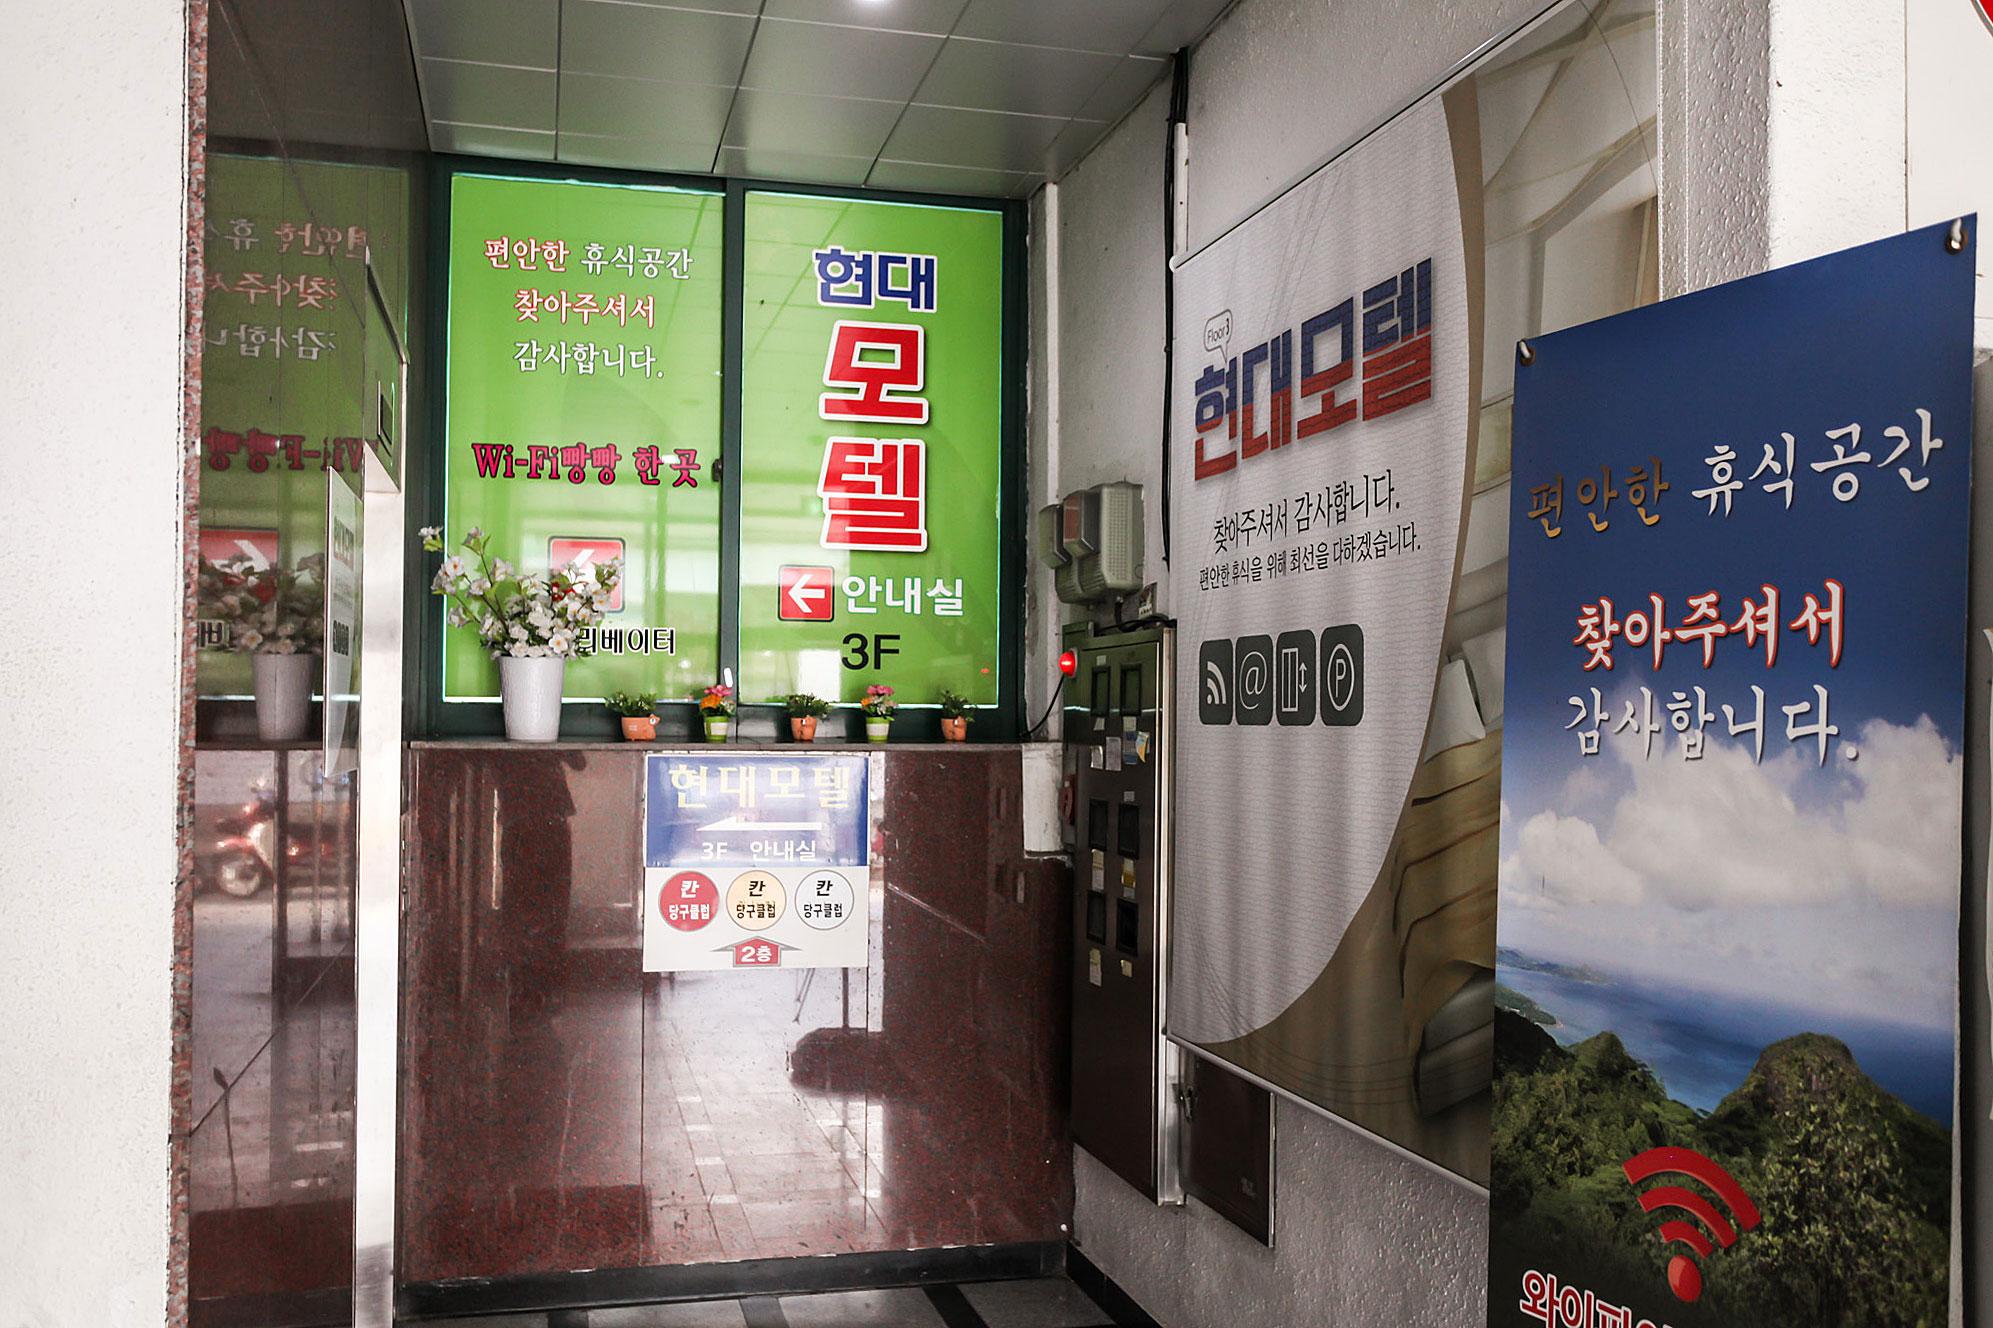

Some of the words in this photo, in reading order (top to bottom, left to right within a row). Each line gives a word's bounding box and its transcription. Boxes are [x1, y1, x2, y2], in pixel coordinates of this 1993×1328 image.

[484, 238, 569, 272] 편안한
[812, 247, 937, 312] 현대
[514, 289, 656, 328] 찾아주셔서
[513, 340, 665, 378] 감사합니다.
[1195, 257, 1432, 481] 현대모텔
[472, 443, 621, 485] Wi-Fi빵빵
[1214, 498, 1288, 554] 찾아주셔서
[1294, 469, 1401, 534] 감사합니다.
[1527, 456, 1671, 538] 편안한
[1200, 563, 1230, 591] 편안한
[1232, 556, 1263, 585] 휴식을
[1266, 551, 1287, 579] 위해
[1290, 542, 1330, 573] 최선을
[1333, 522, 1421, 563] 다하겠습니다.
[841, 575, 963, 618] 안내실
[579, 627, 676, 656] 리베이터
[1573, 578, 1845, 671] 찾아주셔서
[841, 633, 901, 671] 3F
[1564, 684, 1860, 767] 감사합니다.
[669, 764, 851, 808] 현대모텔
[701, 842, 728, 860] 3F
[750, 840, 816, 861] 안내실
[680, 880, 699, 898] 칸
[748, 880, 766, 897] 칸
[815, 880, 833, 897] 칸
[668, 904, 710, 921] 당구클럽
[736, 903, 776, 919] 당구클럽
[803, 903, 843, 918] 당구클럽
[741, 946, 772, 963] 2층
[1520, 1270, 1673, 1328] 와이파
